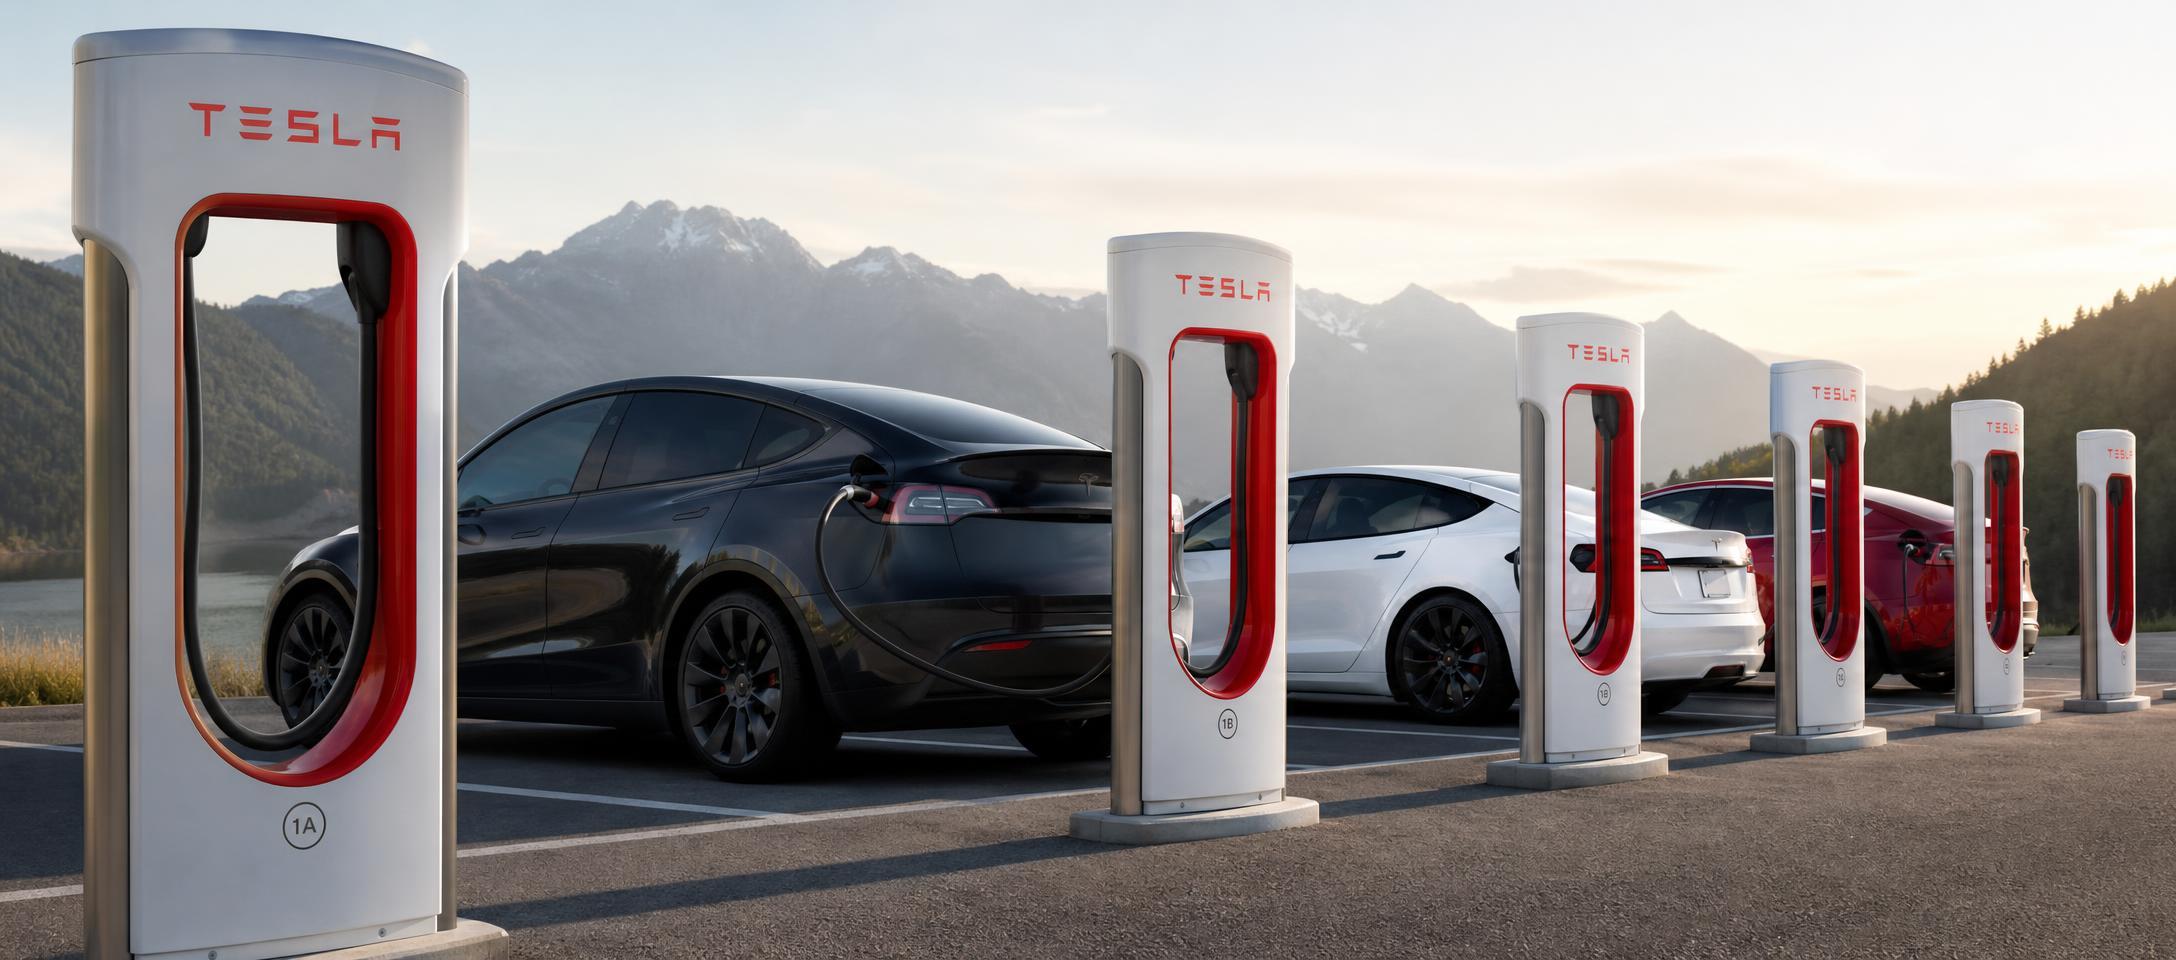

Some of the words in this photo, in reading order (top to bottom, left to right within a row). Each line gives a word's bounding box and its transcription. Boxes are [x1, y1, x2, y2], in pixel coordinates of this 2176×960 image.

[189, 102, 401, 151] TESLA
[1175, 274, 1272, 302] TESLA
[1567, 344, 1630, 364] TESLA
[1812, 386, 1857, 402] TESLA
[1222, 718, 1234, 730] 1B
[292, 816, 317, 835] 1A
